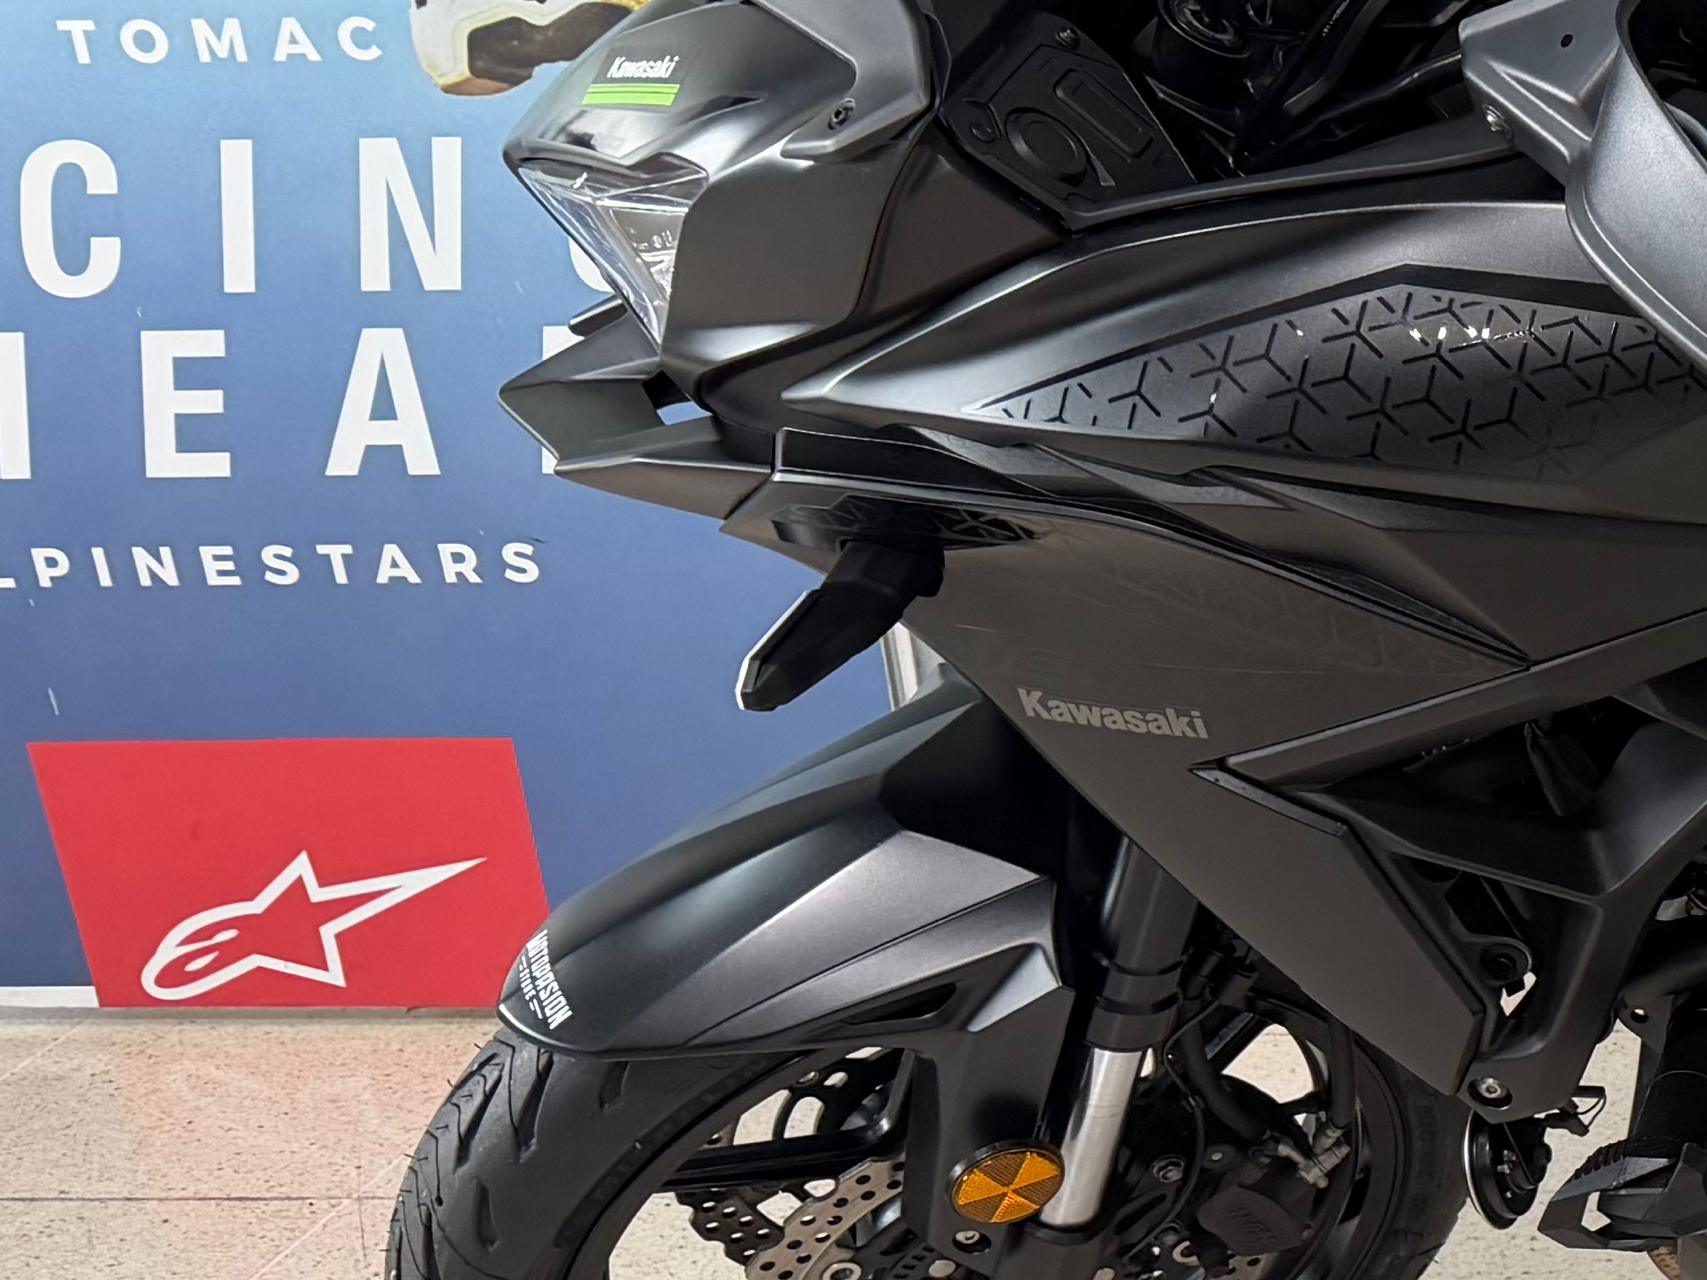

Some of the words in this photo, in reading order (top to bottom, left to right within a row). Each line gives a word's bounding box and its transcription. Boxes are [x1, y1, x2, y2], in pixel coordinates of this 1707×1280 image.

[55, 15, 384, 65] TOMAC
[606, 55, 680, 79] Kawasaki
[20, 137, 615, 298] CIN
[1016, 687, 1209, 739] Kawasaki
[525, 929, 574, 1030] MOTOPASION
